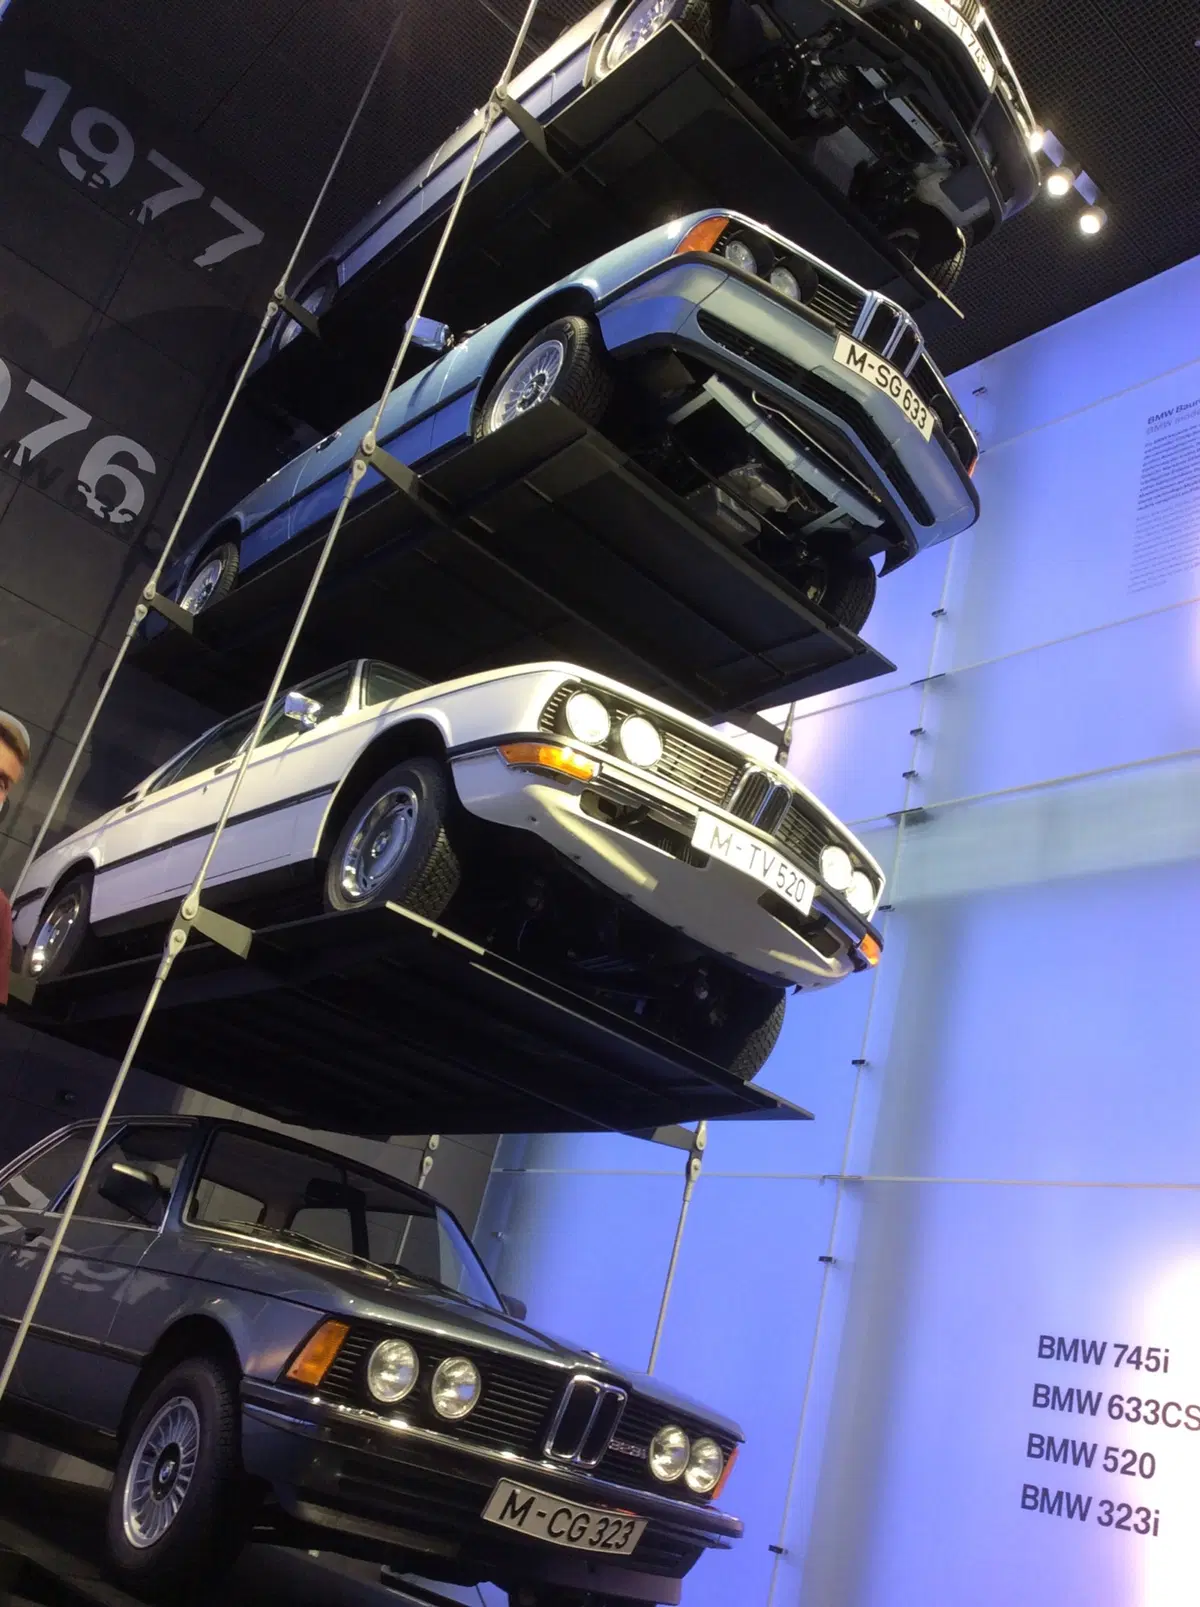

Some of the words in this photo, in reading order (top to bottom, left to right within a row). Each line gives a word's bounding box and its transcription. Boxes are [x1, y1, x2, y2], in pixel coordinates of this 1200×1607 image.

[21, 68, 265, 271] 1977
[846, 344, 903, 398] M-SG
[902, 388, 928, 430] 633
[0, 357, 156, 525] 76
[1148, 407, 1174, 425] BMW
[709, 825, 776, 878] M-TV
[775, 862, 806, 903] 520
[1037, 1334, 1108, 1366] BMW
[1113, 1343, 1170, 1374] 745i
[1032, 1383, 1103, 1417] BMW
[1107, 1393, 1200, 1431] 633CS
[1026, 1432, 1098, 1469] BMW
[1102, 1446, 1156, 1480] 520
[500, 1489, 590, 1543] M-CG
[588, 1516, 636, 1550] 323
[1020, 1483, 1093, 1522] BMW
[1096, 1499, 1160, 1537] 323i
